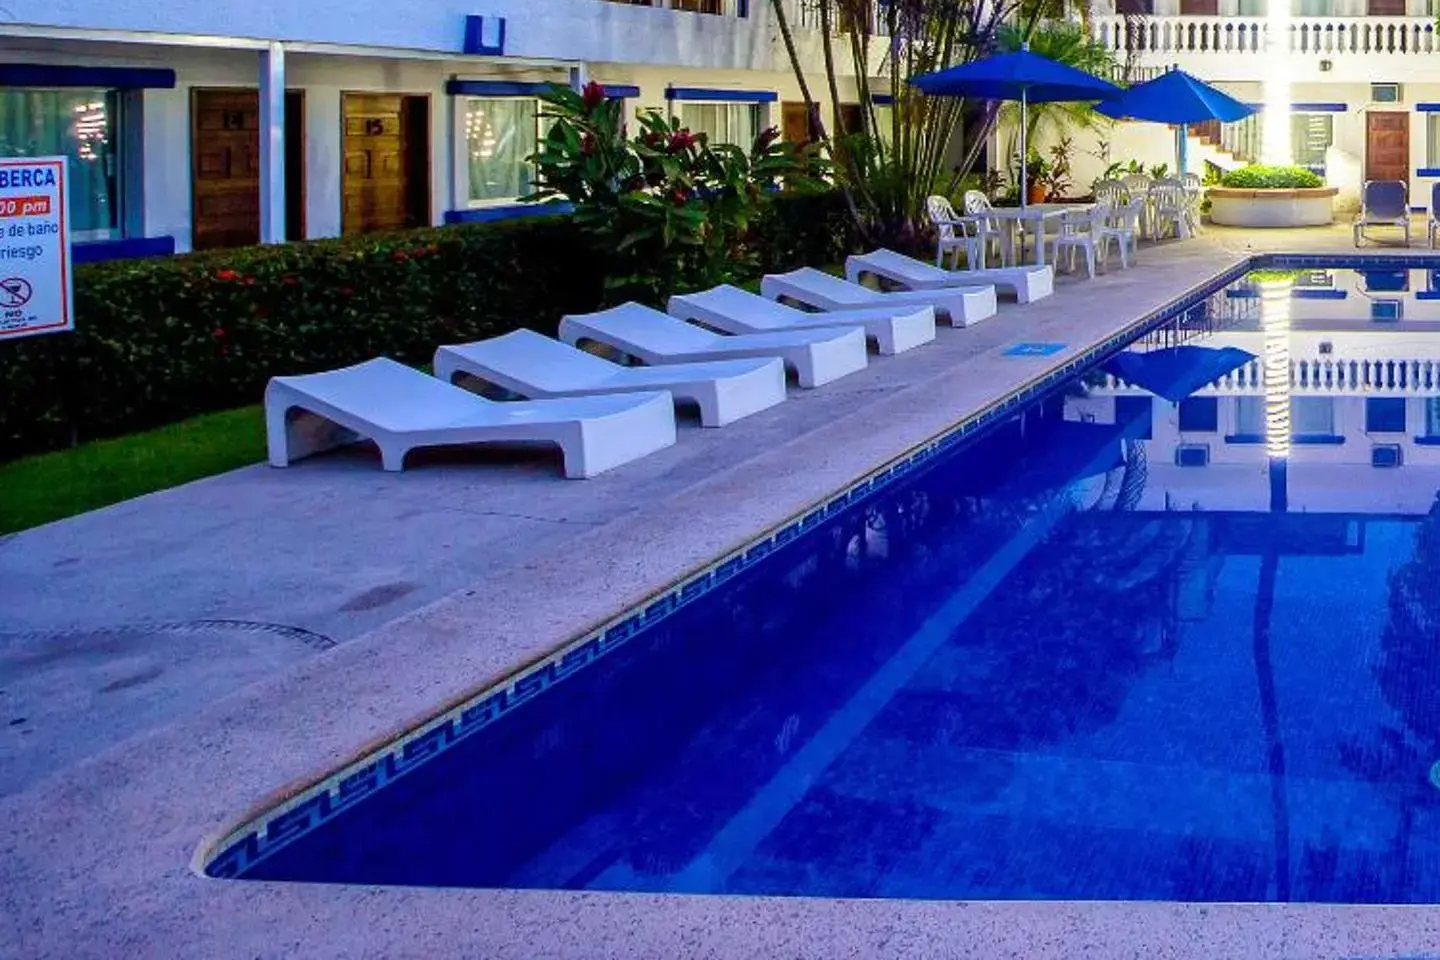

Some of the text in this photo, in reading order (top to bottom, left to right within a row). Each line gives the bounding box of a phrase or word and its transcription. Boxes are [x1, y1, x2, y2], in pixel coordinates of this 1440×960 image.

[366, 119, 384, 136] 15
[0, 168, 56, 188] BERCA
[22, 201, 47, 217] pm
[9, 224, 24, 237] de
[28, 220, 58, 236] baño
[1, 245, 43, 260] riesgo
